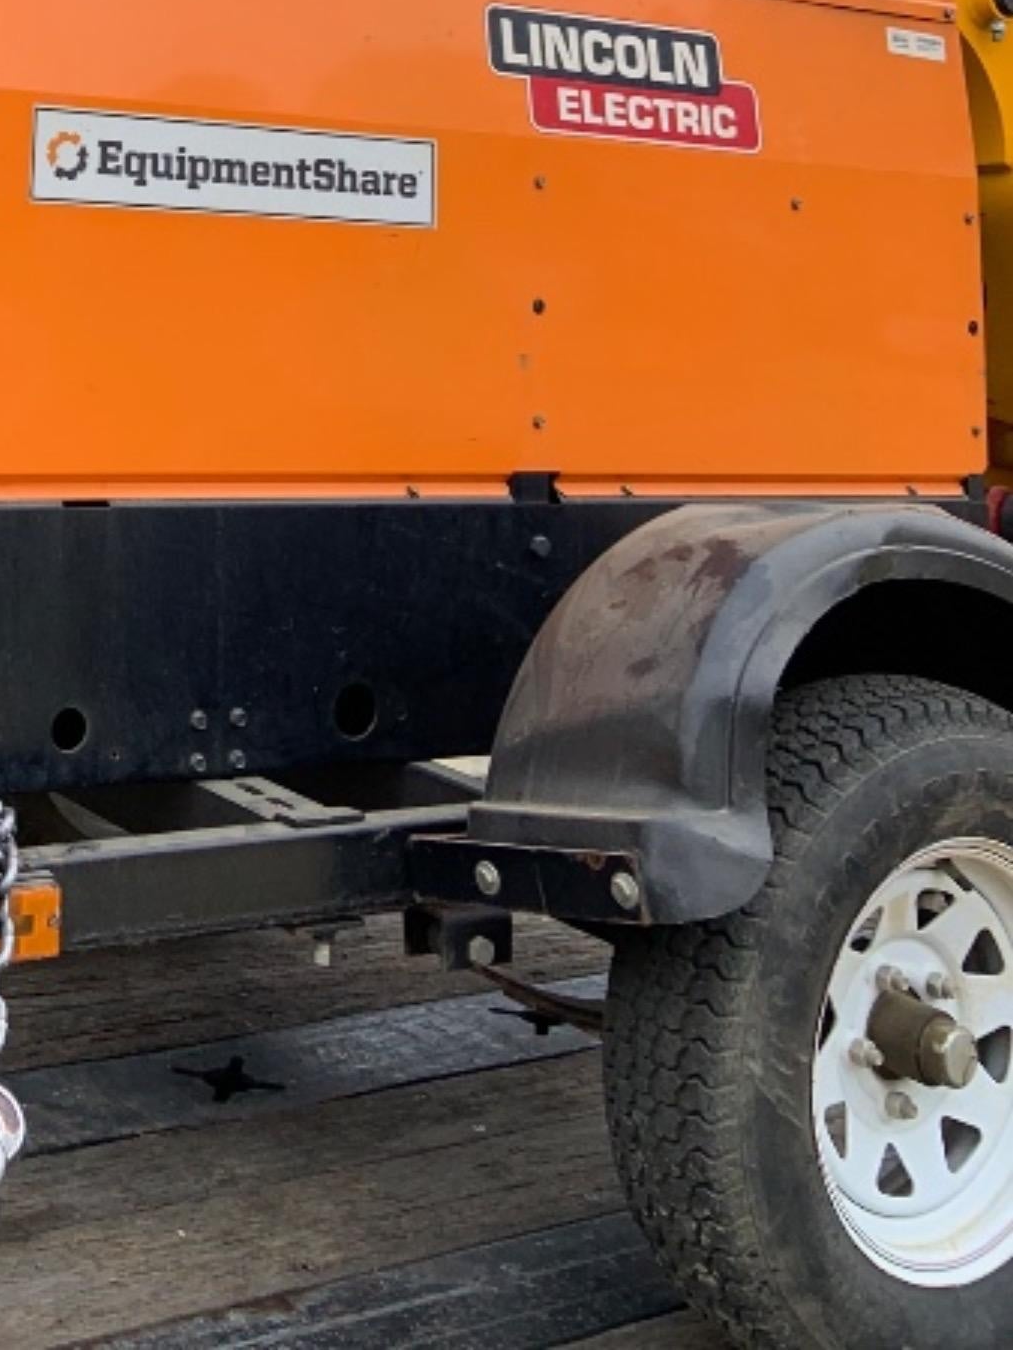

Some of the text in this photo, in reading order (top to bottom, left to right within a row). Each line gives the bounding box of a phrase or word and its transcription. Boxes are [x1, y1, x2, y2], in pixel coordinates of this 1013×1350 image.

[499, 16, 710, 88] LINCOLN
[556, 85, 738, 140] ELECTRIC
[96, 139, 419, 199] EquipmentShare
